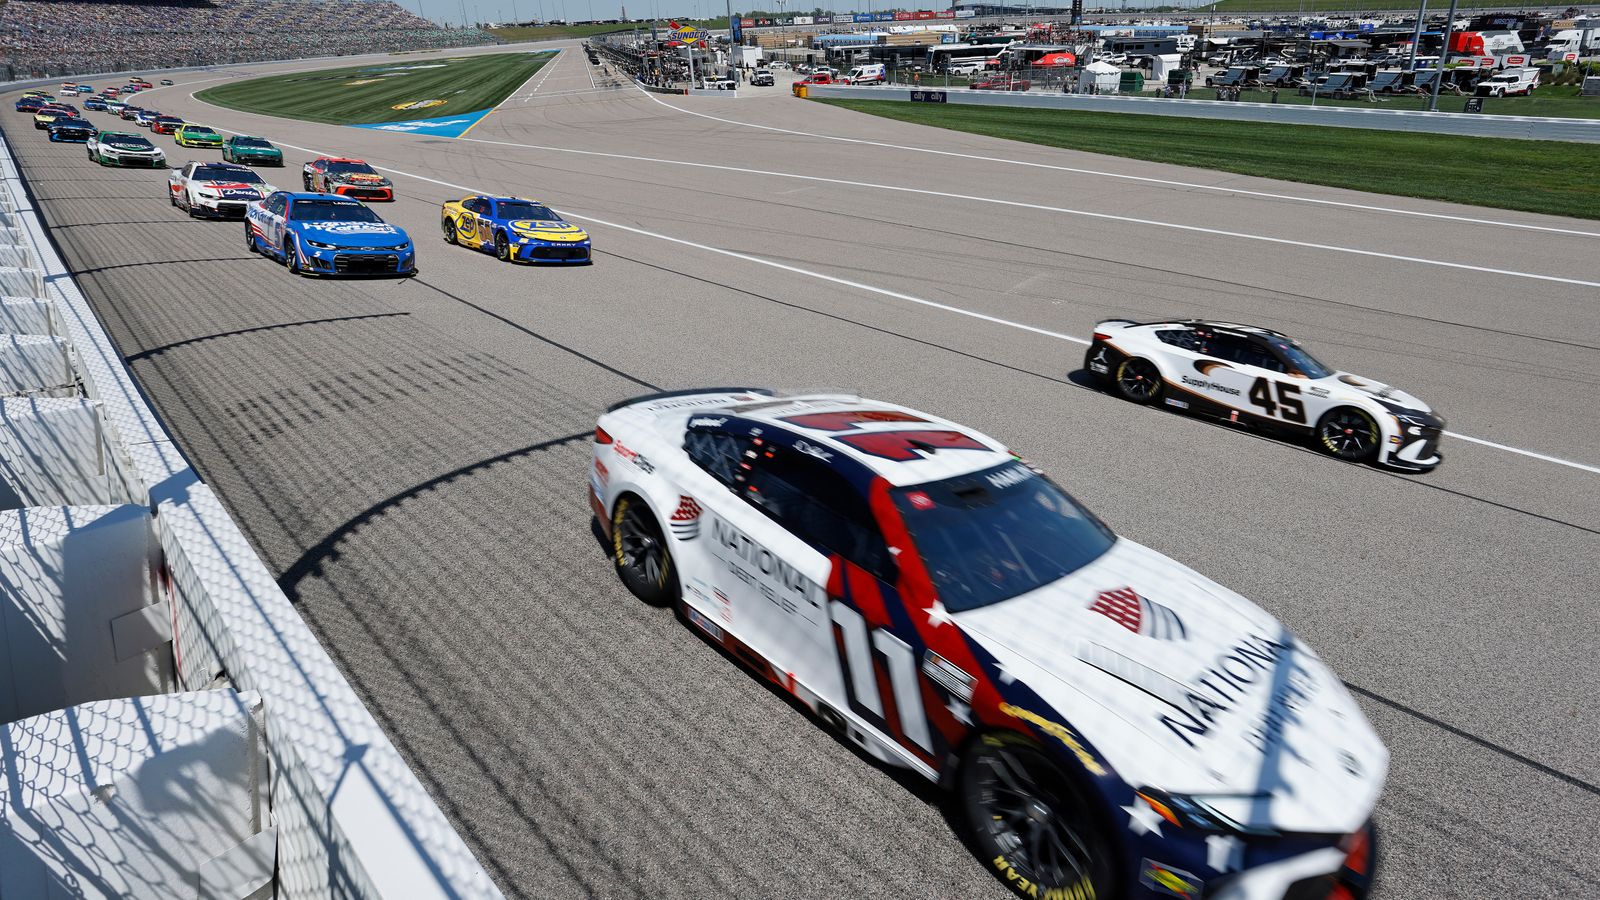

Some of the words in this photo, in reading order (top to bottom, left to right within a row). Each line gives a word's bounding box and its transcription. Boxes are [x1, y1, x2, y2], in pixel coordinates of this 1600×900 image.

[671, 31, 706, 40] SUNOCO
[914, 91, 926, 102] ally
[931, 92, 943, 102] ally
[1181, 374, 1242, 397] SupplyHouse
[1248, 376, 1307, 425] 45
[711, 517, 821, 610] NATIONAL
[829, 600, 938, 763] 11
[1157, 633, 1294, 750] NATIONA
